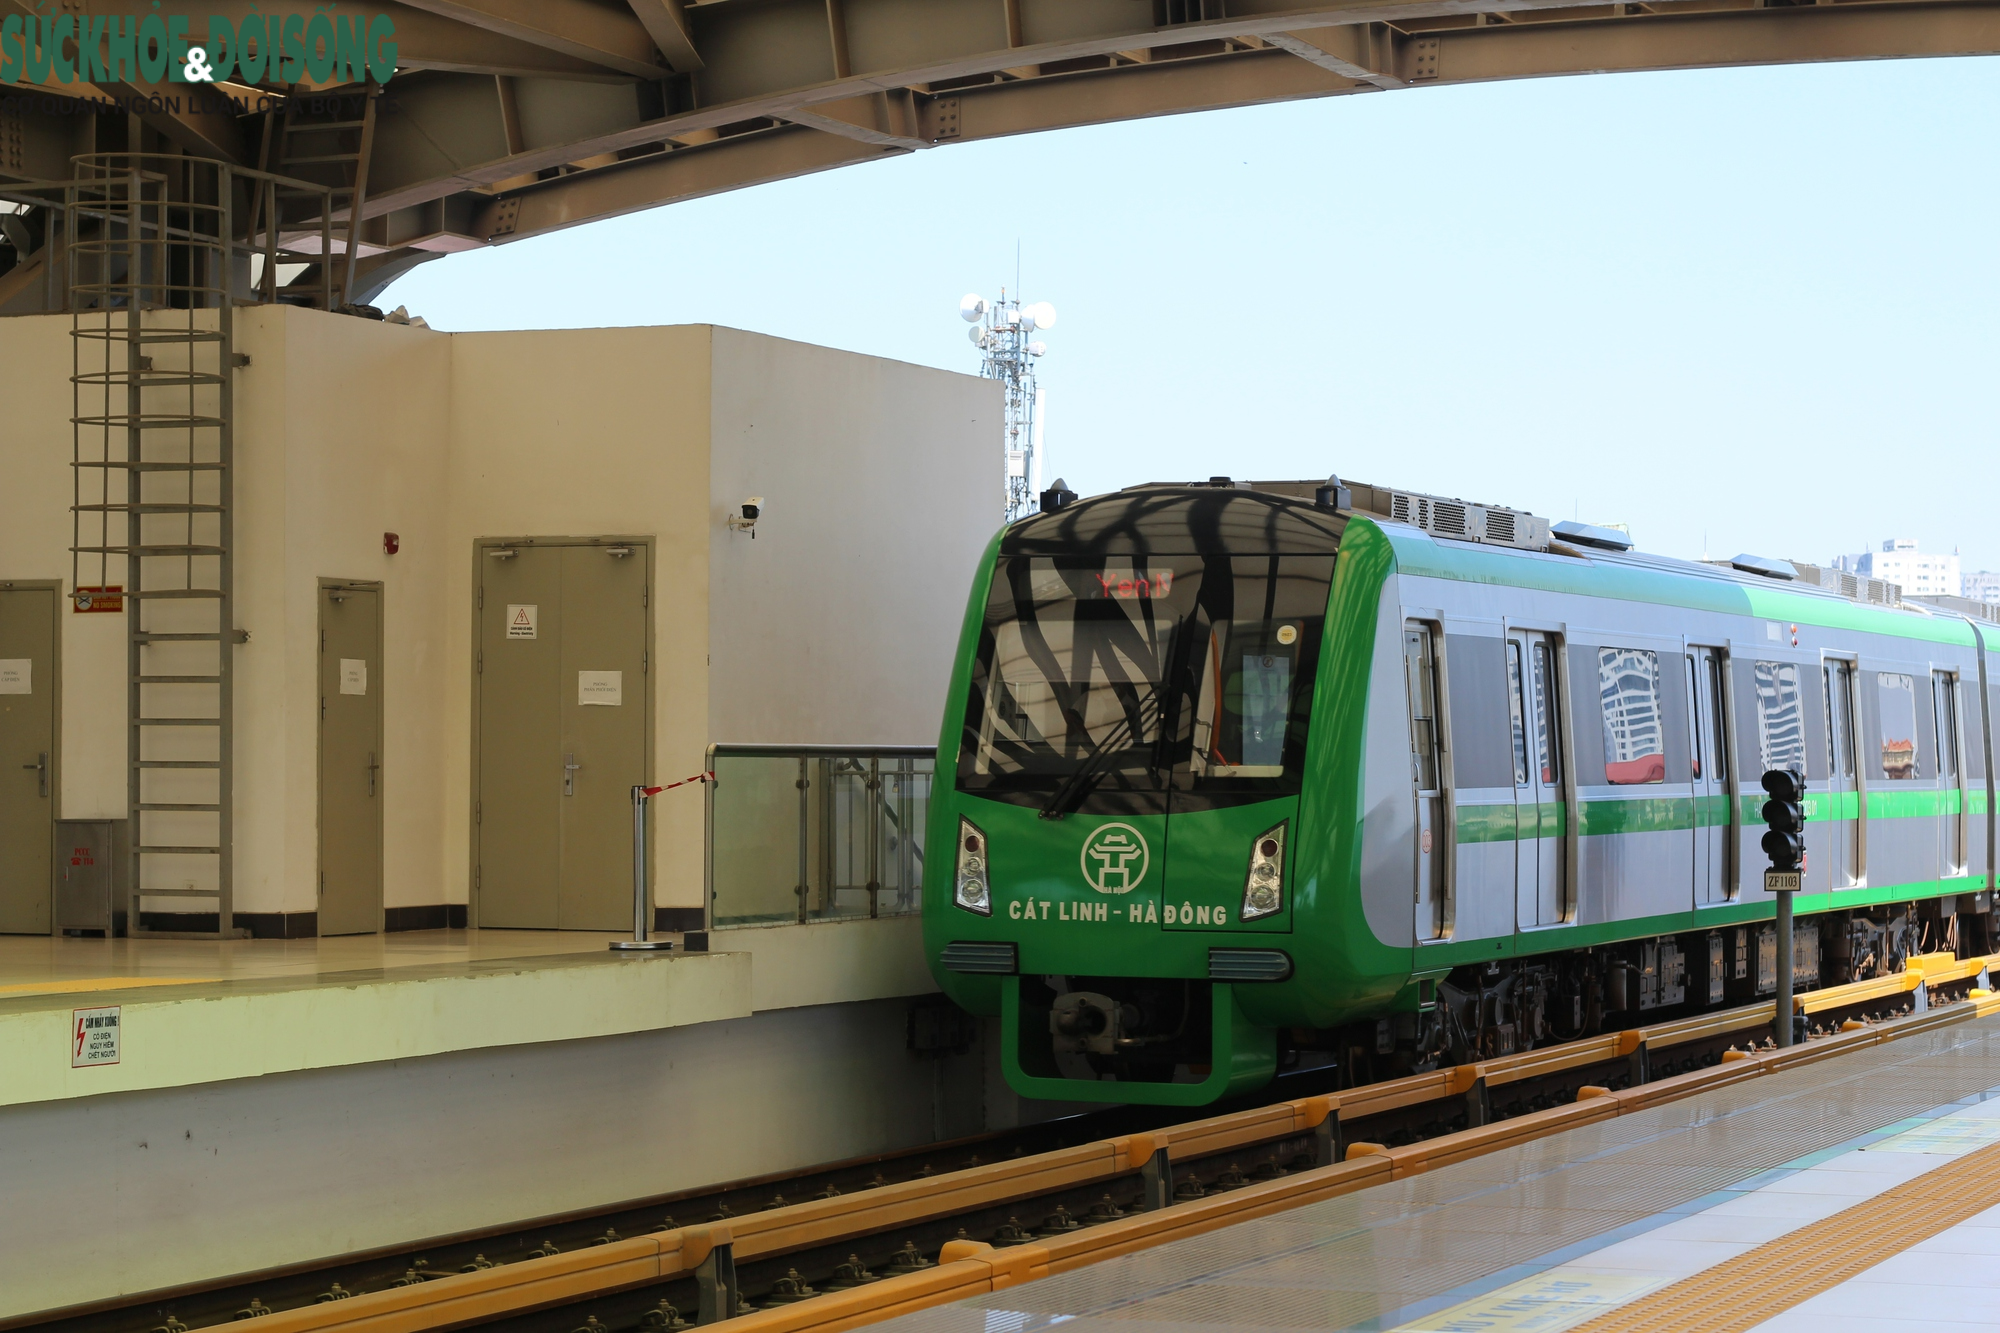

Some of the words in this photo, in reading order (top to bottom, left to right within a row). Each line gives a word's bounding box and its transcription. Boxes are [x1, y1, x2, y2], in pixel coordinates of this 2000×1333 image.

[100, 601, 121, 609] SMOKING
[1009, 897, 1051, 920] CÁT
[1059, 901, 1108, 921] LINH
[1129, 900, 1158, 924] HÀ
[1163, 901, 1227, 925] ĐÔNG
[93, 1032, 100, 1040] CÓ
[100, 1032, 111, 1041] ĐIỆN
[90, 1042, 102, 1050] NGUY
